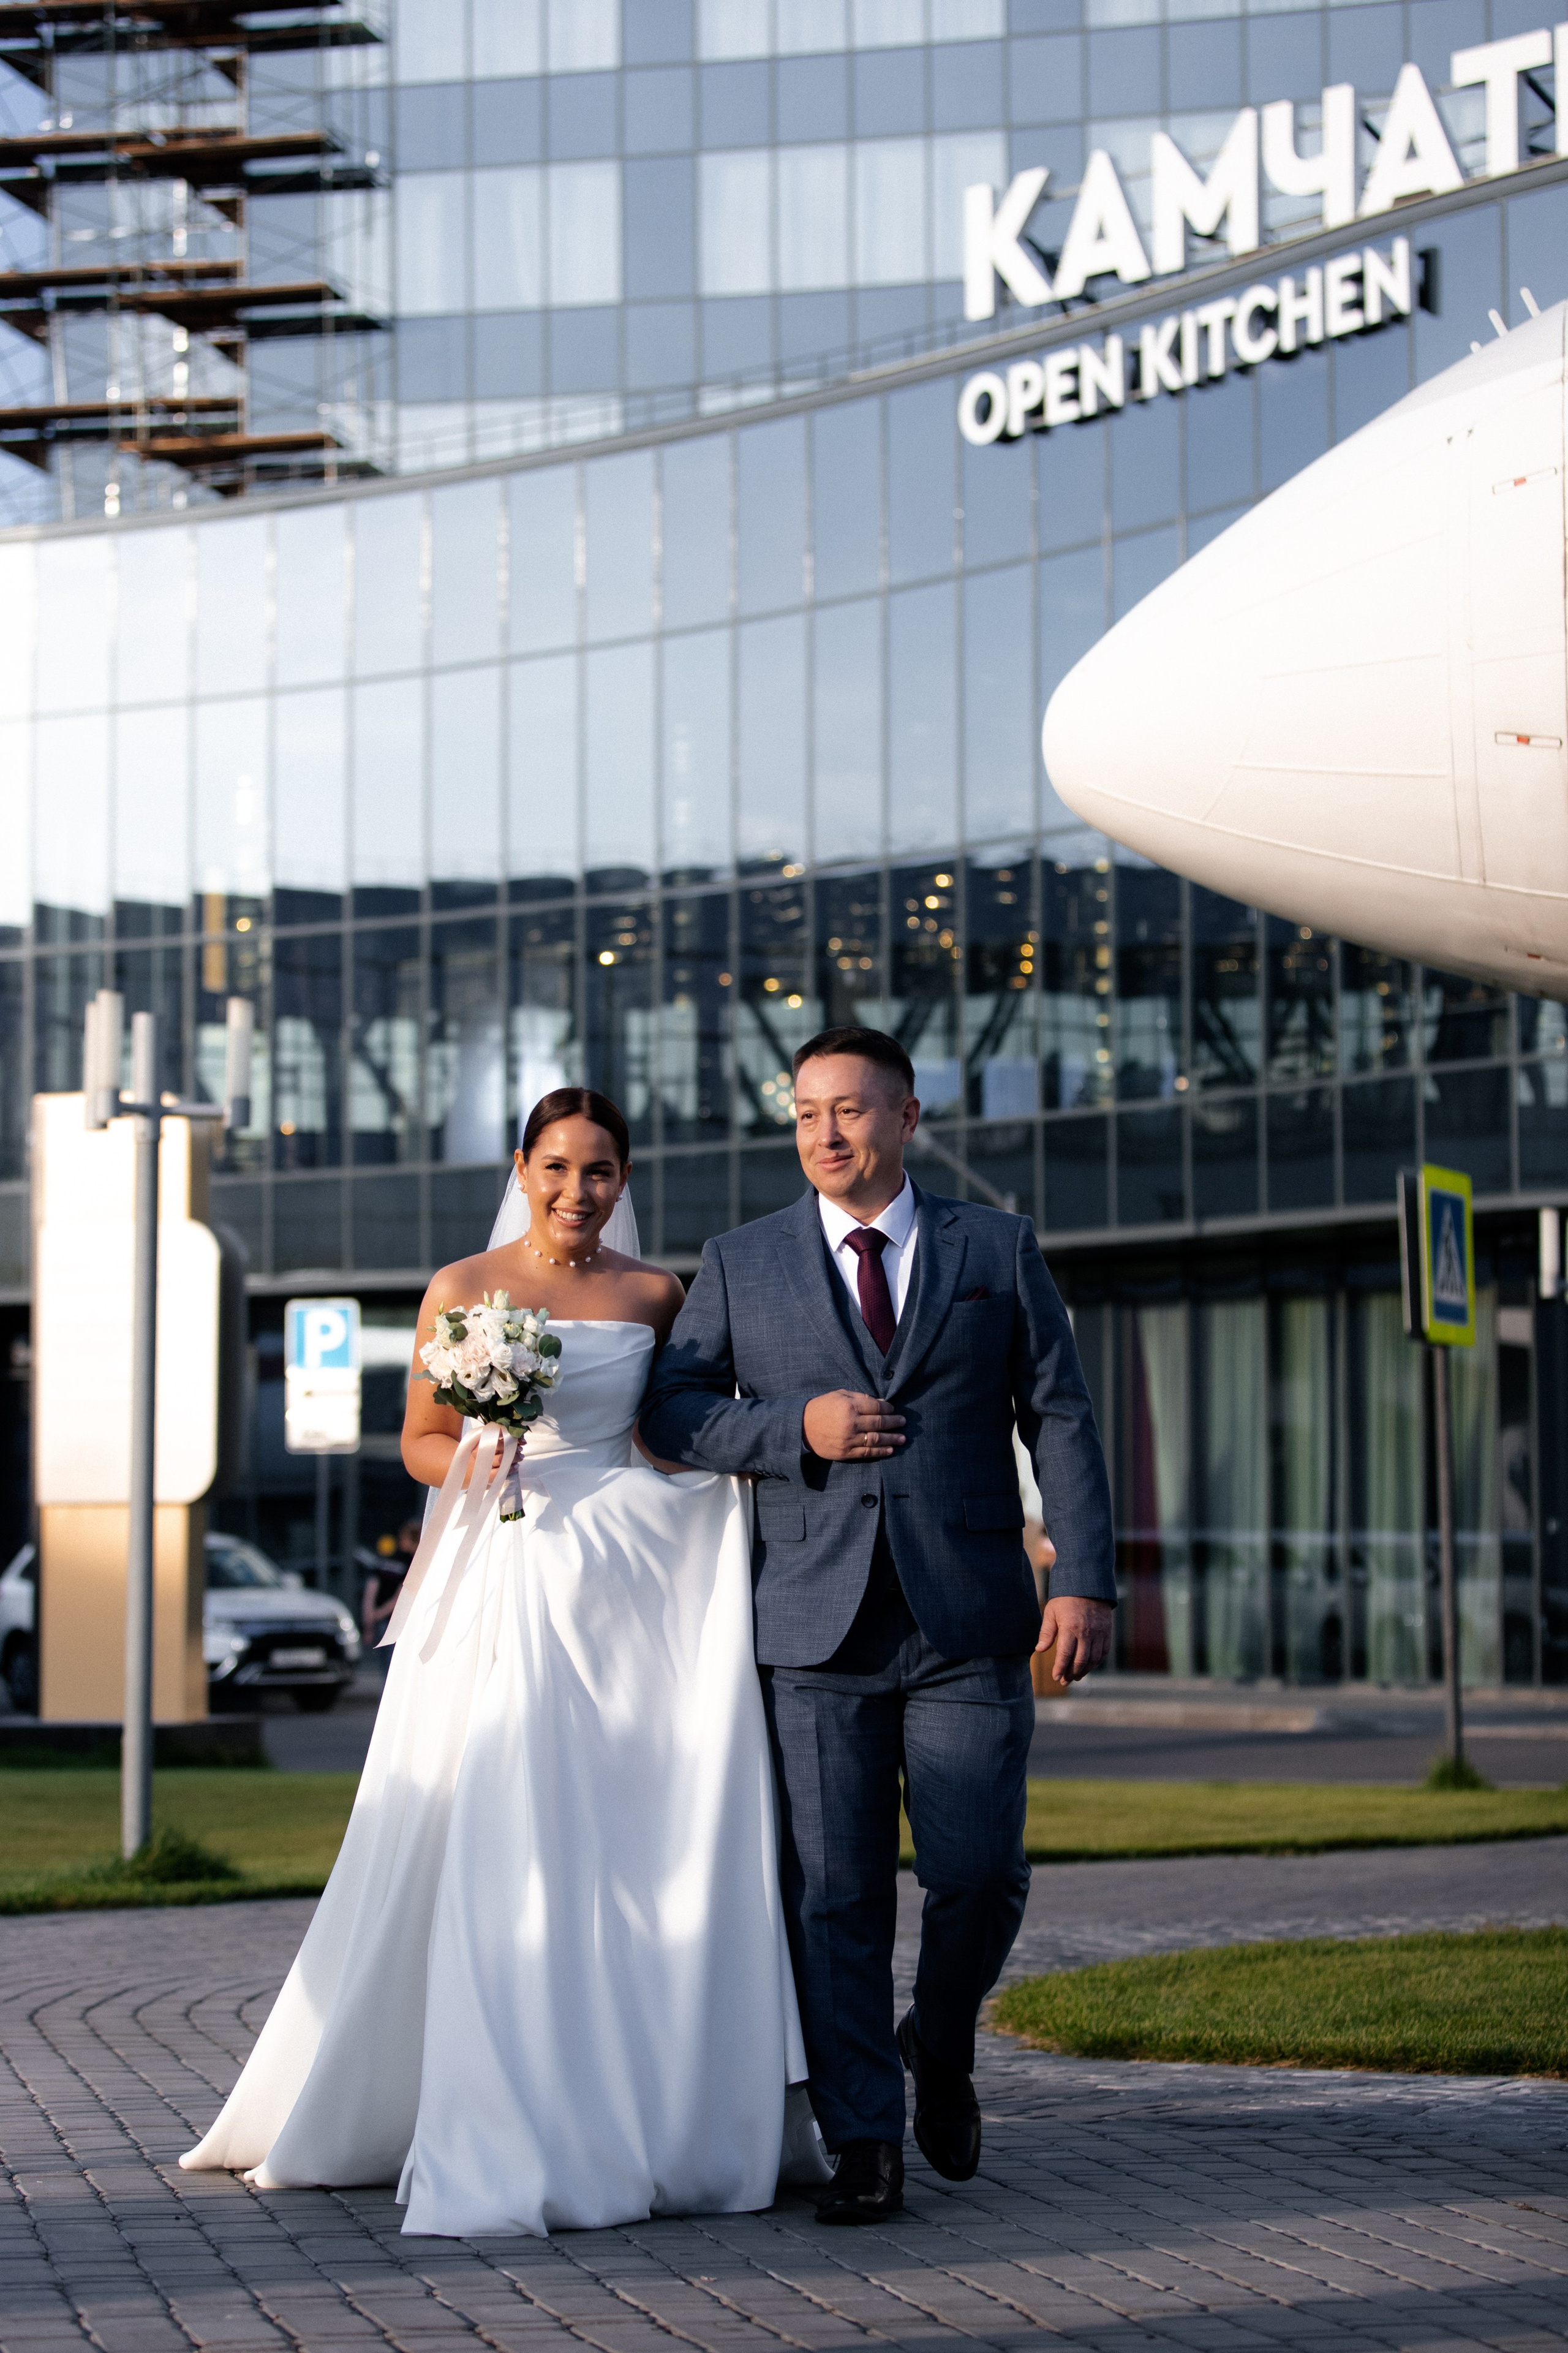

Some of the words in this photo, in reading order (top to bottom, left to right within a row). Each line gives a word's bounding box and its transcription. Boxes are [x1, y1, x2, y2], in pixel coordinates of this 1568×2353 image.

[963, 22, 1568, 322] КАМЧАТ
[958, 334, 1125, 446] OPEN
[1139, 237, 1412, 399] KITCHEN
[304, 1309, 347, 1367] P
